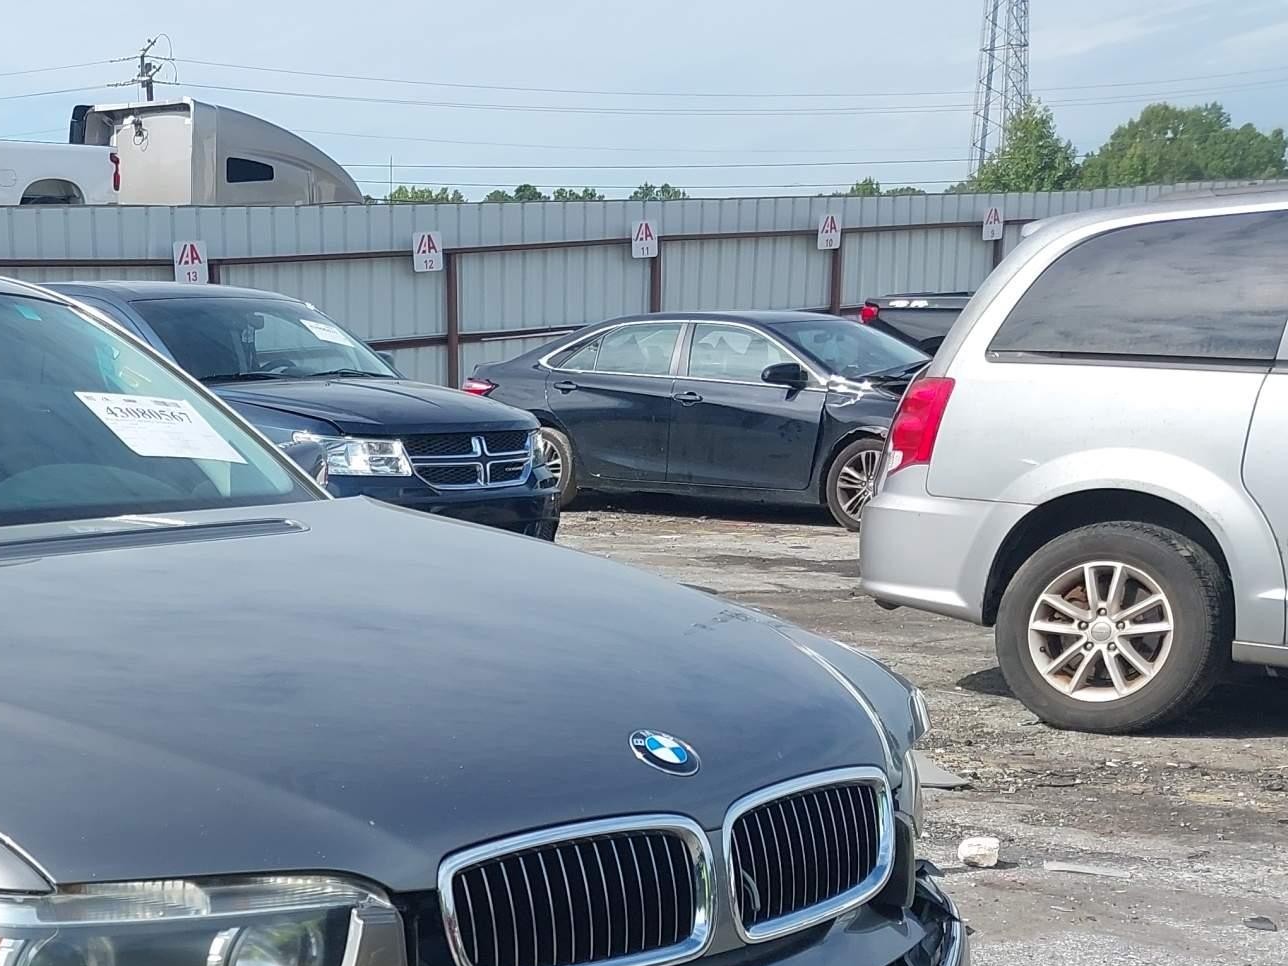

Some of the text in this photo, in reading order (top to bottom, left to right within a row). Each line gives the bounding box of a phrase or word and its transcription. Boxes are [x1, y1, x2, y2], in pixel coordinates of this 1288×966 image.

[640, 246, 649, 256] 11
[423, 259, 434, 270] 12
[186, 271, 198, 283] 13
[105, 405, 193, 424] 43080567
